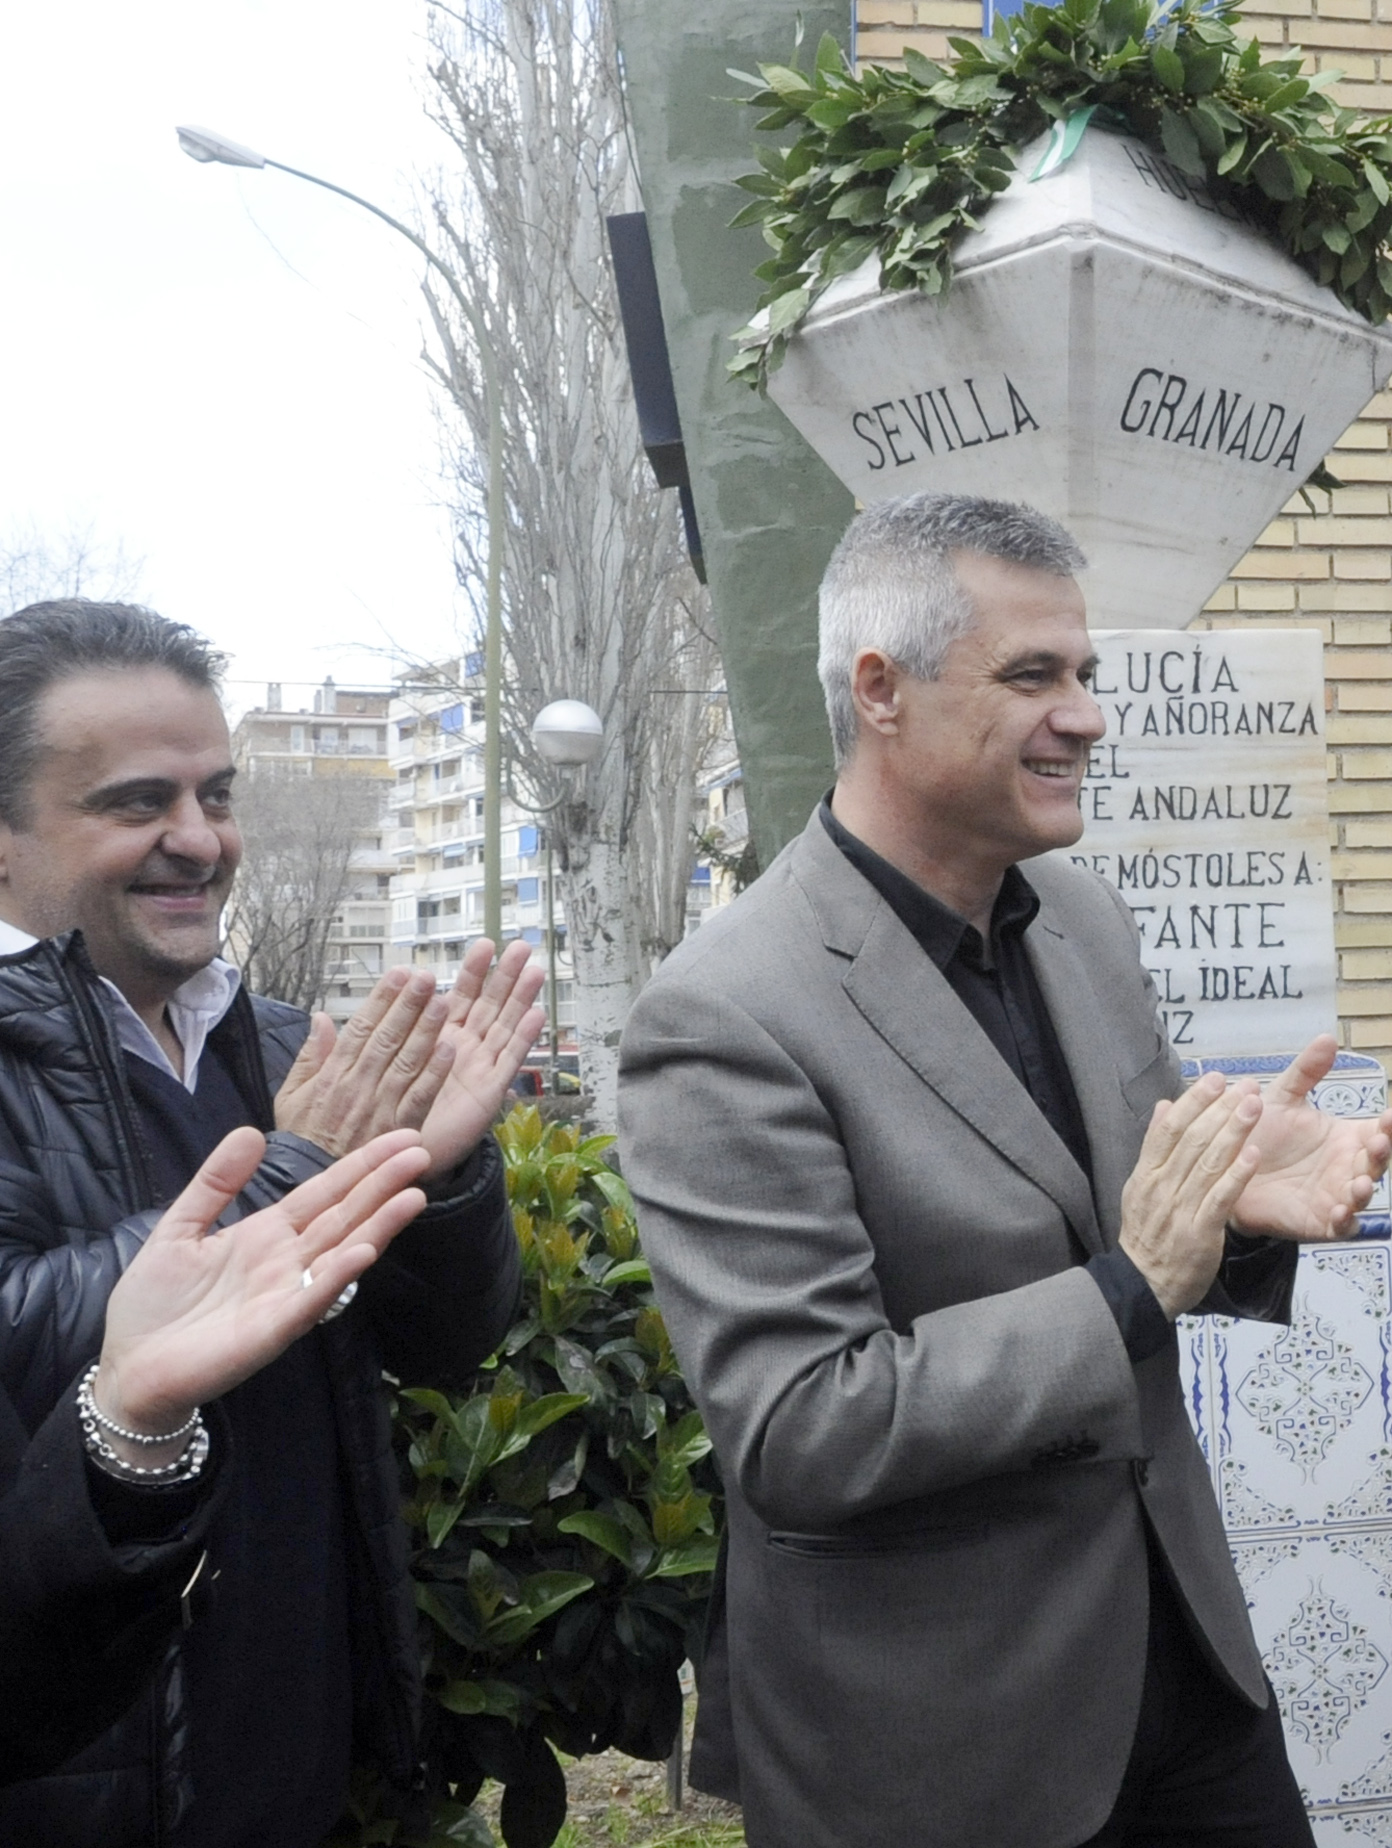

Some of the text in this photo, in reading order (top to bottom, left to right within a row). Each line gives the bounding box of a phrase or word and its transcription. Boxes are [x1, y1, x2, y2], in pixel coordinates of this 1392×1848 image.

[852, 373, 1040, 470] SEVILLA
[1120, 367, 1305, 471] GRANADA
[1114, 695, 1319, 736] Y AÑORANZA
[1129, 784, 1293, 821] ANDALUZ
[1117, 848, 1286, 890] MÓSTOLES
[1293, 852, 1323, 886] A:
